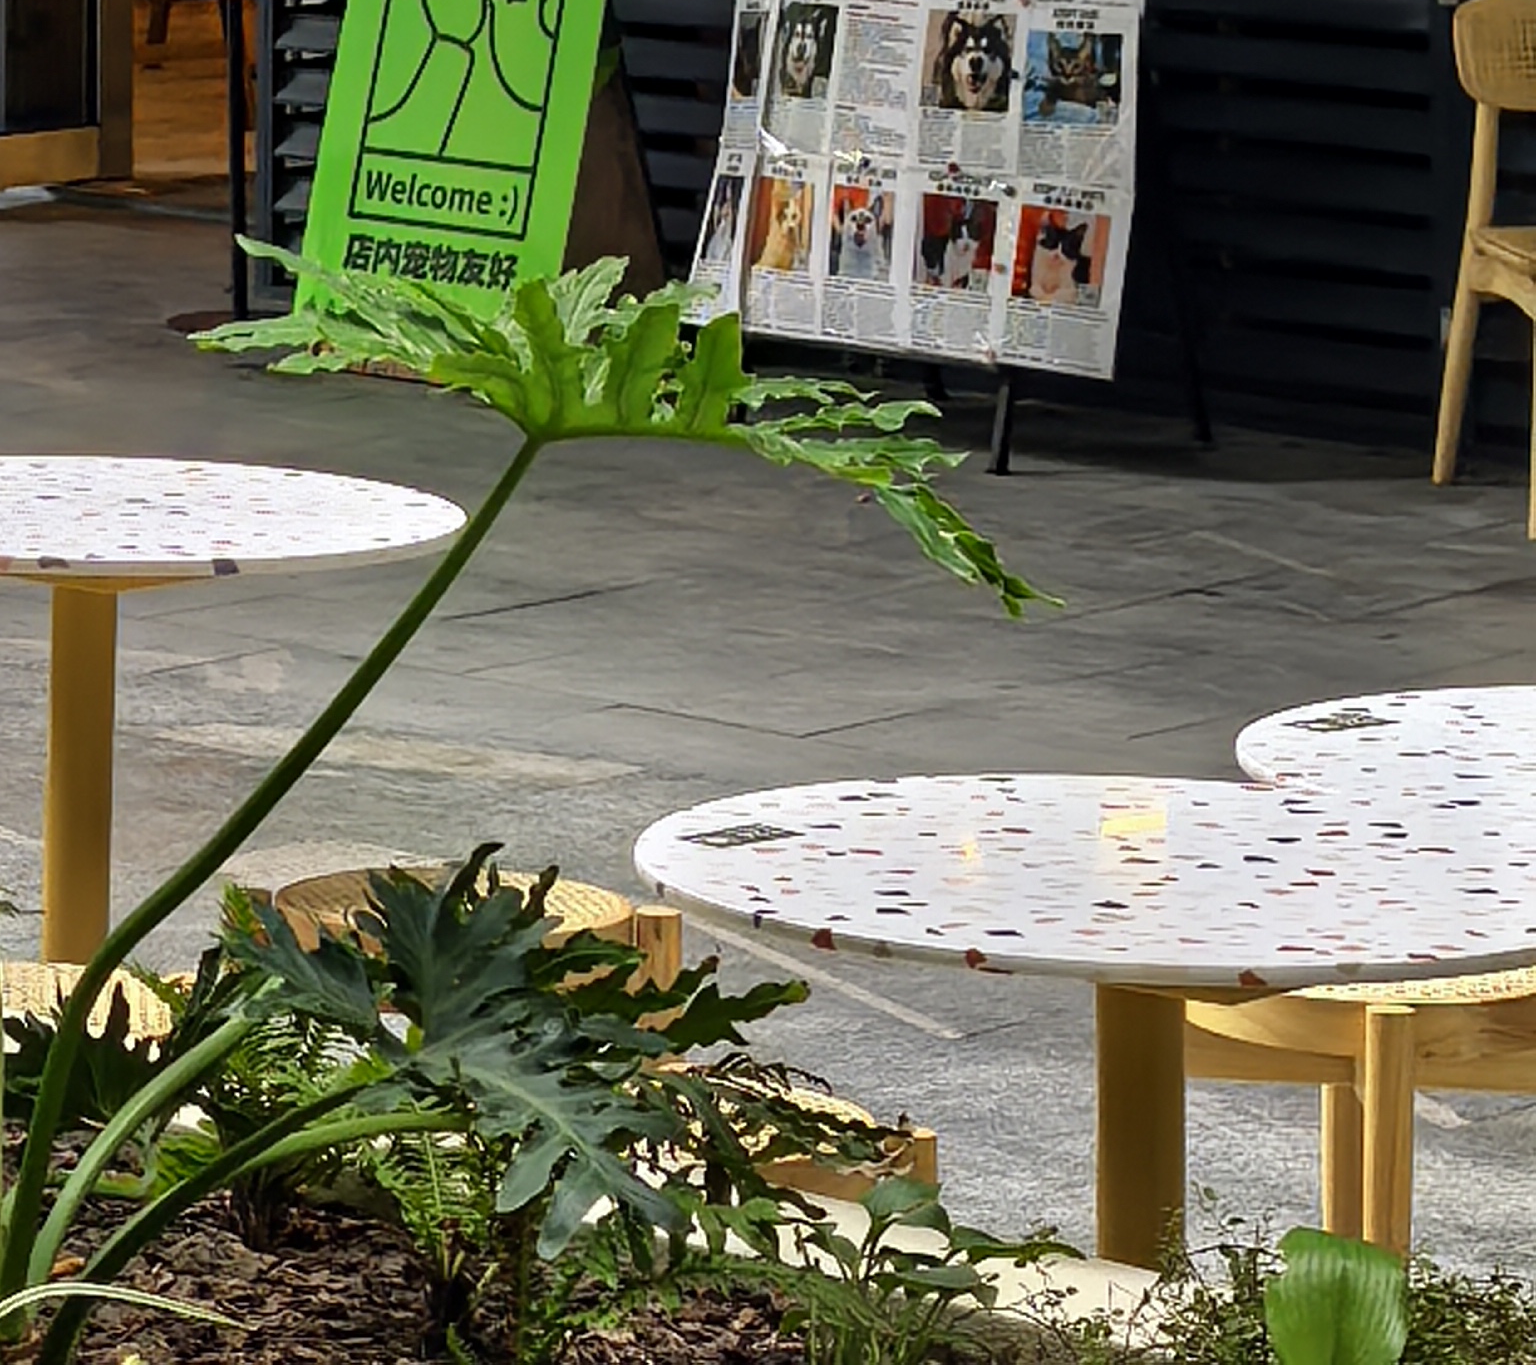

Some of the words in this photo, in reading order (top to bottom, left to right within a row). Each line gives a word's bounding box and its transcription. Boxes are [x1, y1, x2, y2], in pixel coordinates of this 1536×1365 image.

[366, 170, 492, 215] Welcome
[342, 234, 519, 291] 店内宠物友好
